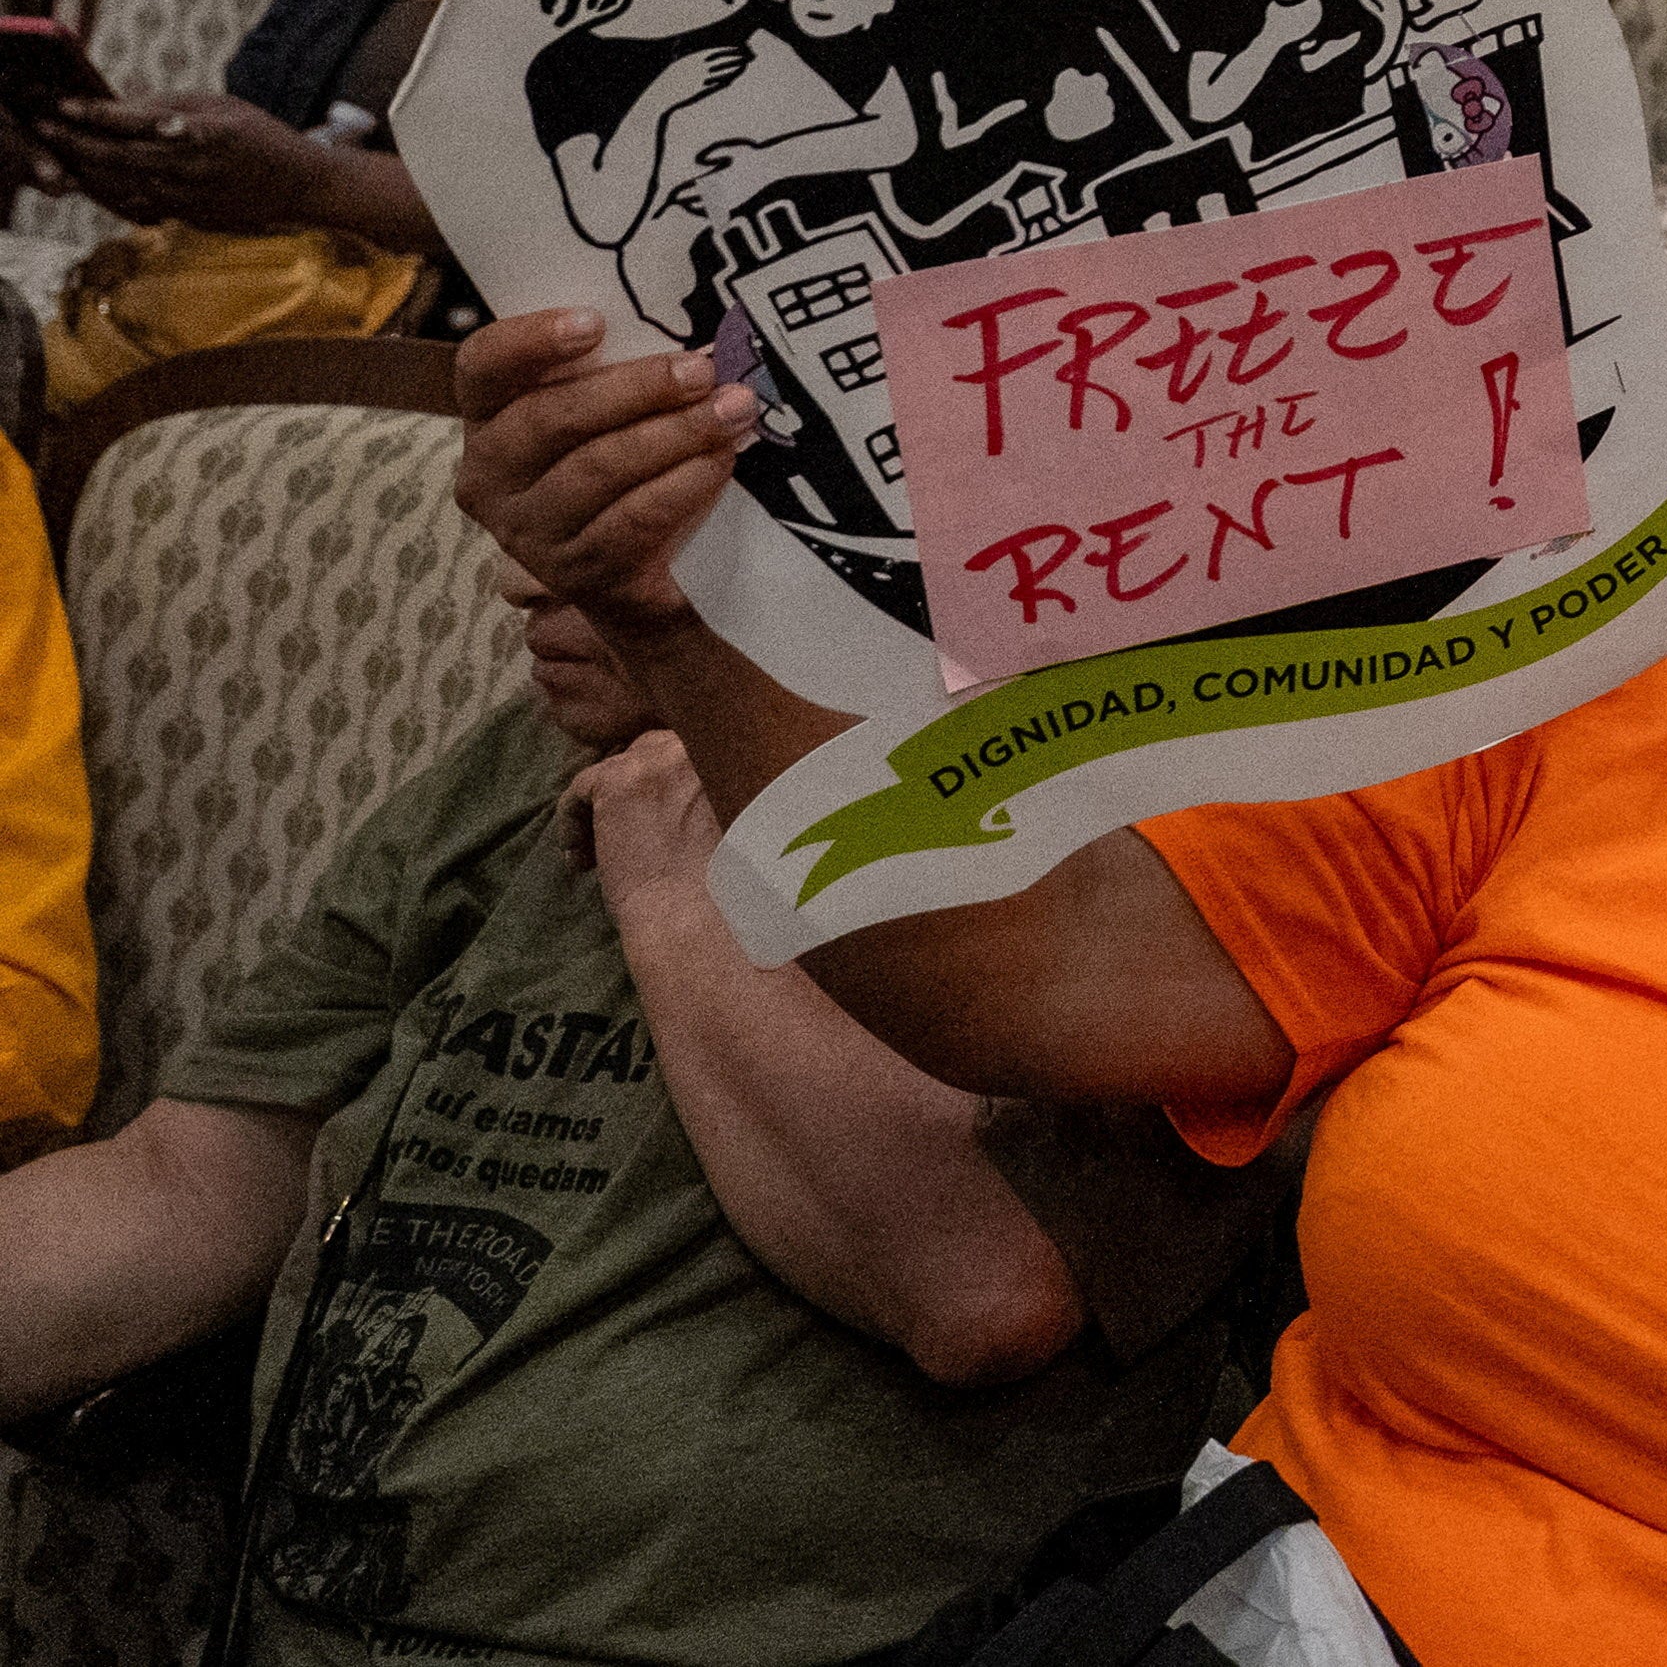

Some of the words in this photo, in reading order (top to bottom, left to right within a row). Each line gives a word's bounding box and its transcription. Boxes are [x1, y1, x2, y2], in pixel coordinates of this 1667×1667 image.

[942, 216, 1546, 456] FREEZE
[1164, 389, 1320, 470] THE
[964, 448, 1406, 625] RENT
[928, 680, 1178, 800] DIGNIDAD,
[1191, 634, 1478, 702] COMUNIDAD
[1487, 621, 1517, 651] Y
[441, 1008, 656, 1084] ASTA!
[477, 1156, 610, 1193] quedam
[406, 1218, 480, 1250] THE
